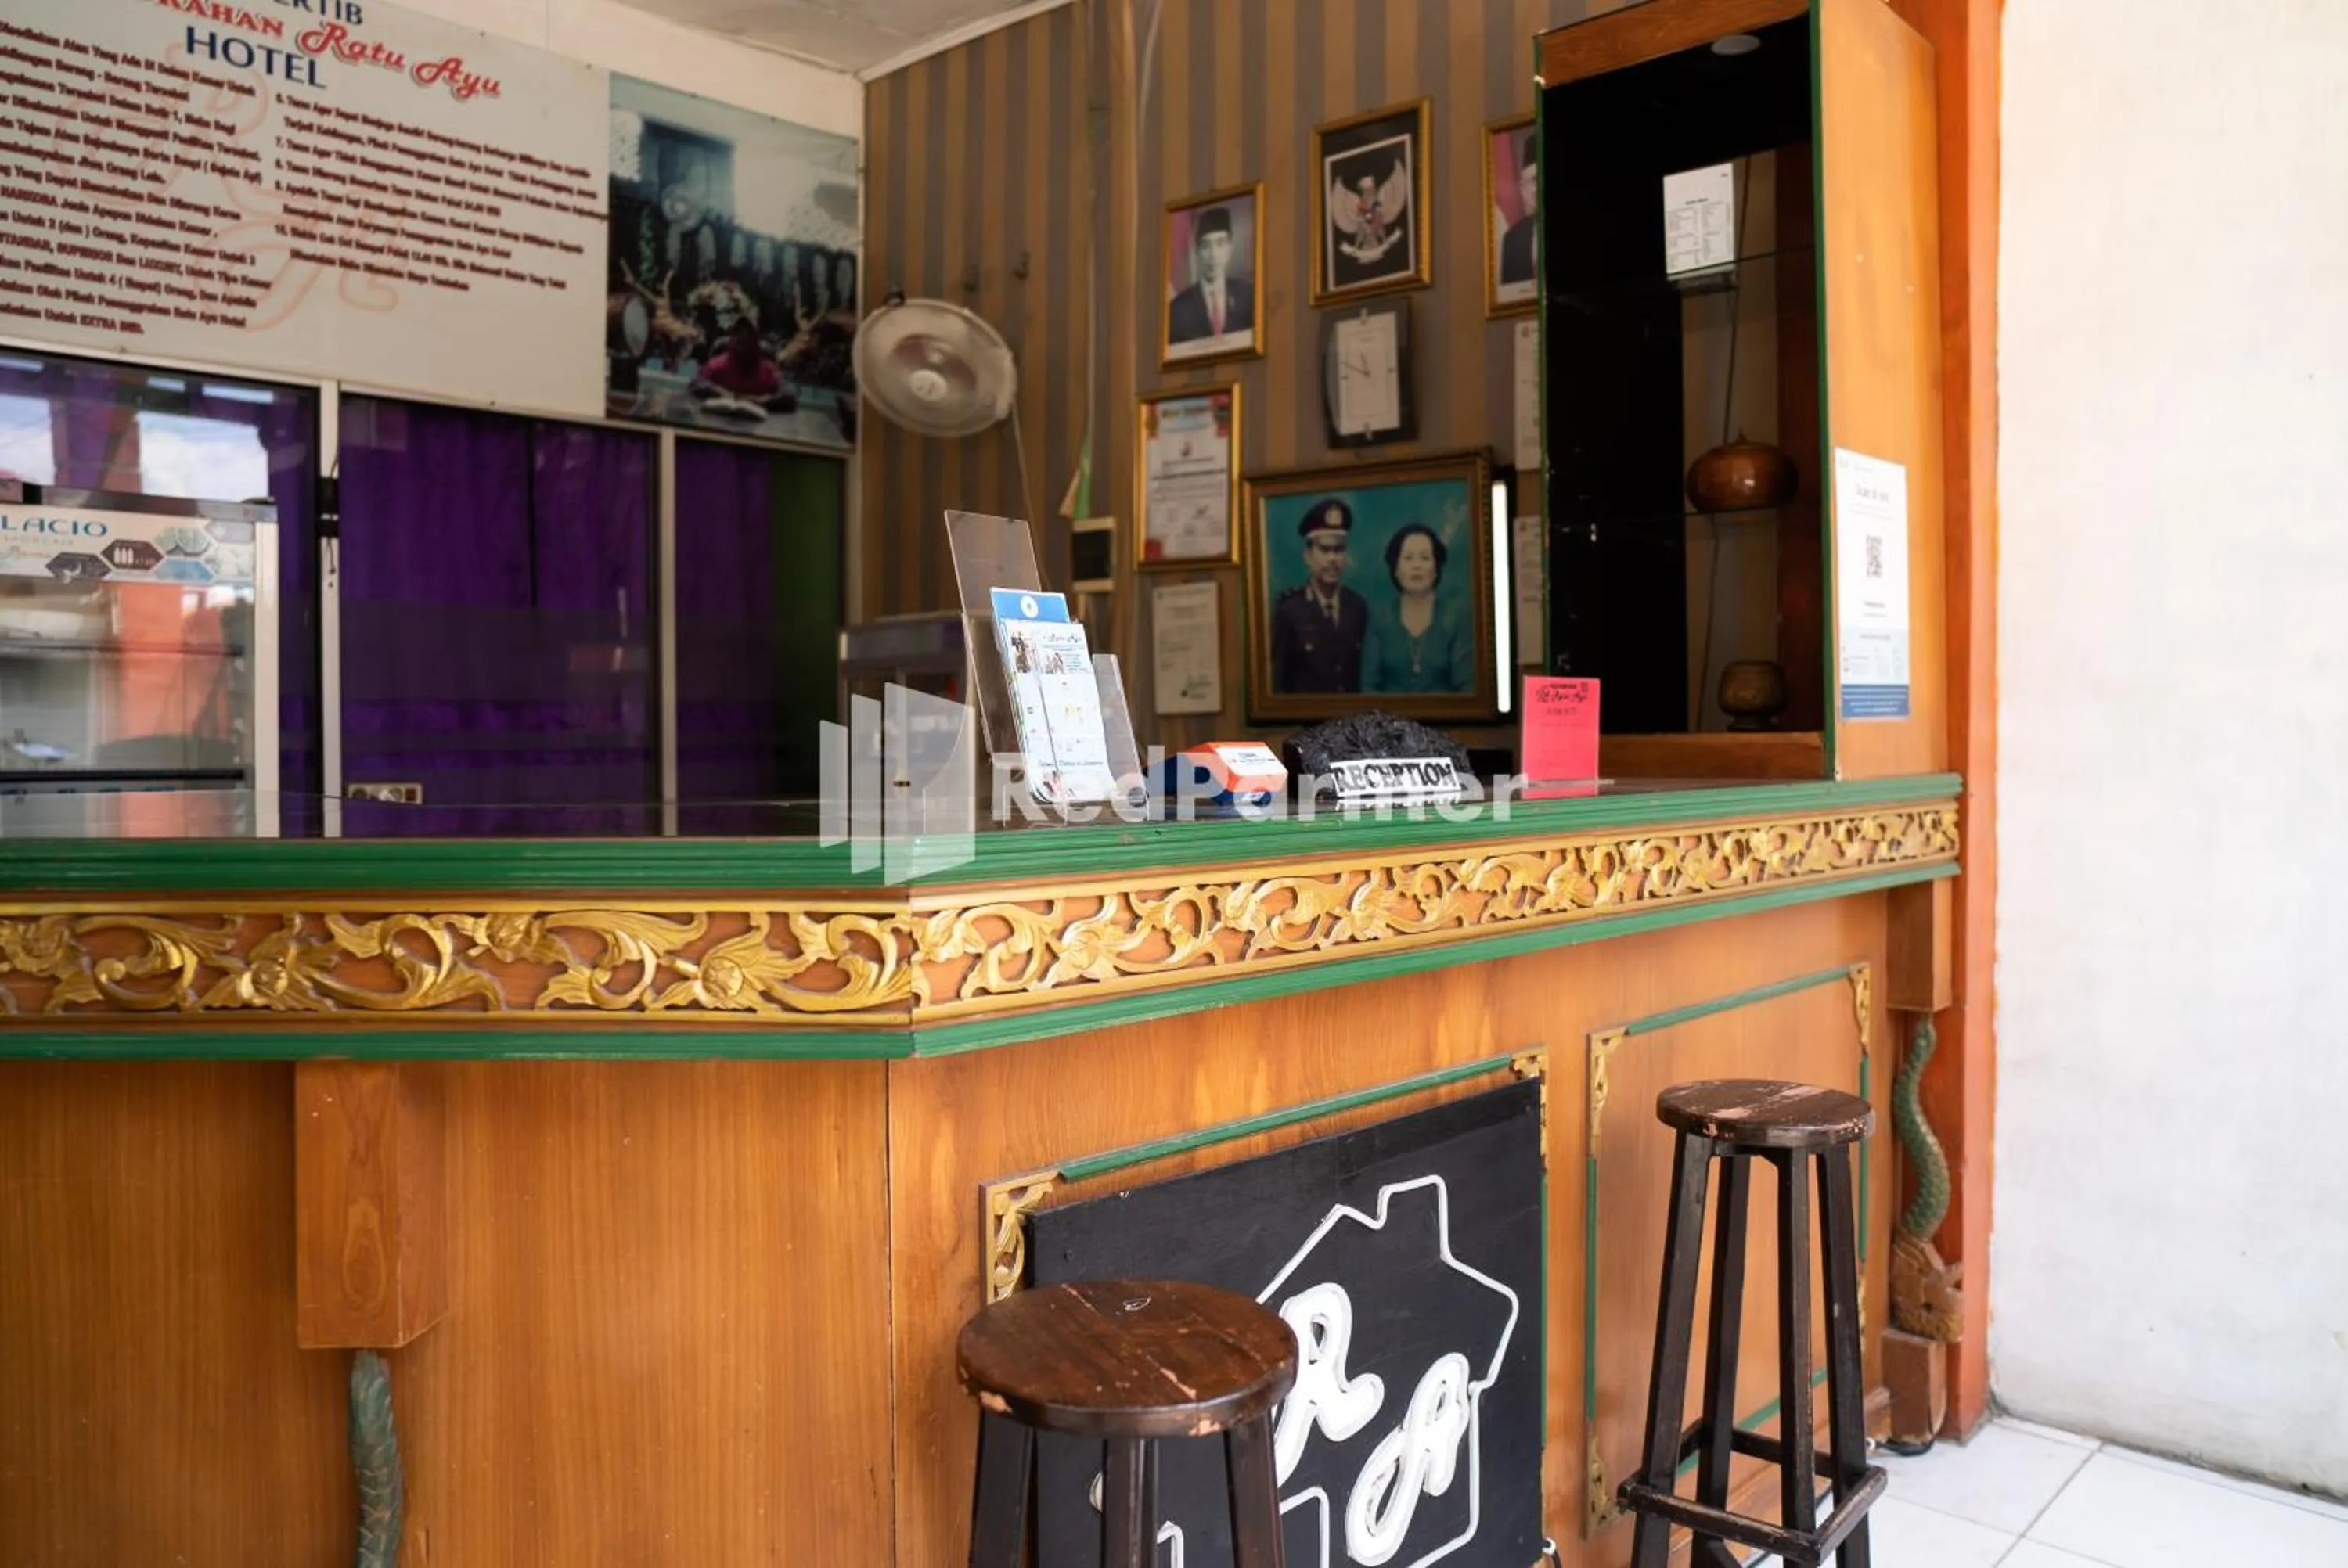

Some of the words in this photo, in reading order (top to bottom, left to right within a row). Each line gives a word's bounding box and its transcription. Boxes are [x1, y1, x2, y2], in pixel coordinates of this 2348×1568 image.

[186, 24, 327, 90] HOTEL
[298, 21, 405, 66] Ratu
[412, 56, 502, 100] Ayu
[1, 515, 108, 537] LACIO
[1330, 762, 1458, 793] RECEPTION
